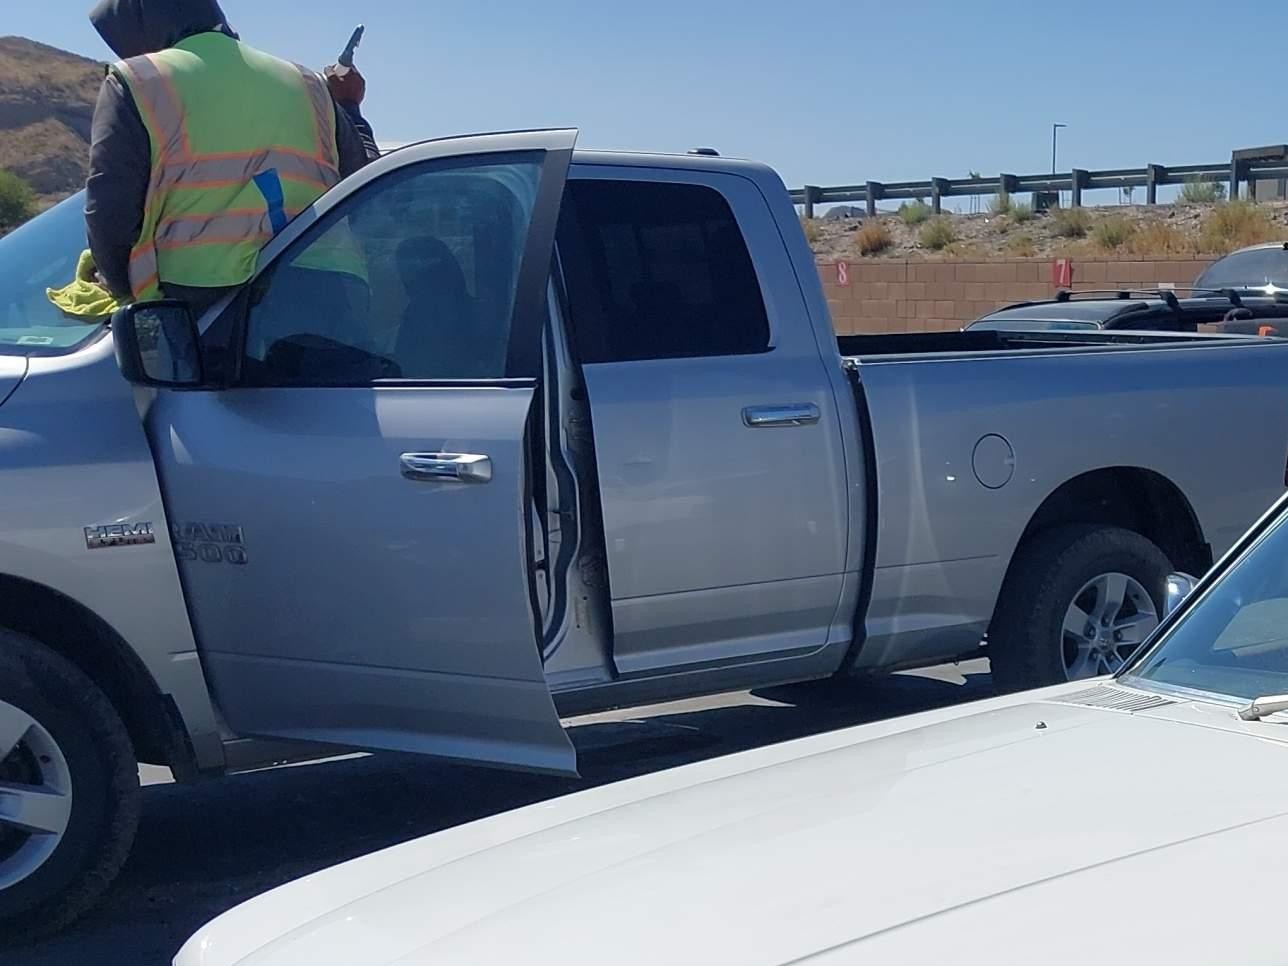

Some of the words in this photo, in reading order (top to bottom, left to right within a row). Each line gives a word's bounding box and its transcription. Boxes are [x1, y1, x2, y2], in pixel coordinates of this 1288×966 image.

[837, 261, 848, 284] 8
[1056, 259, 1067, 284] 7
[84, 522, 154, 541] HEMI
[174, 543, 249, 566] 500
